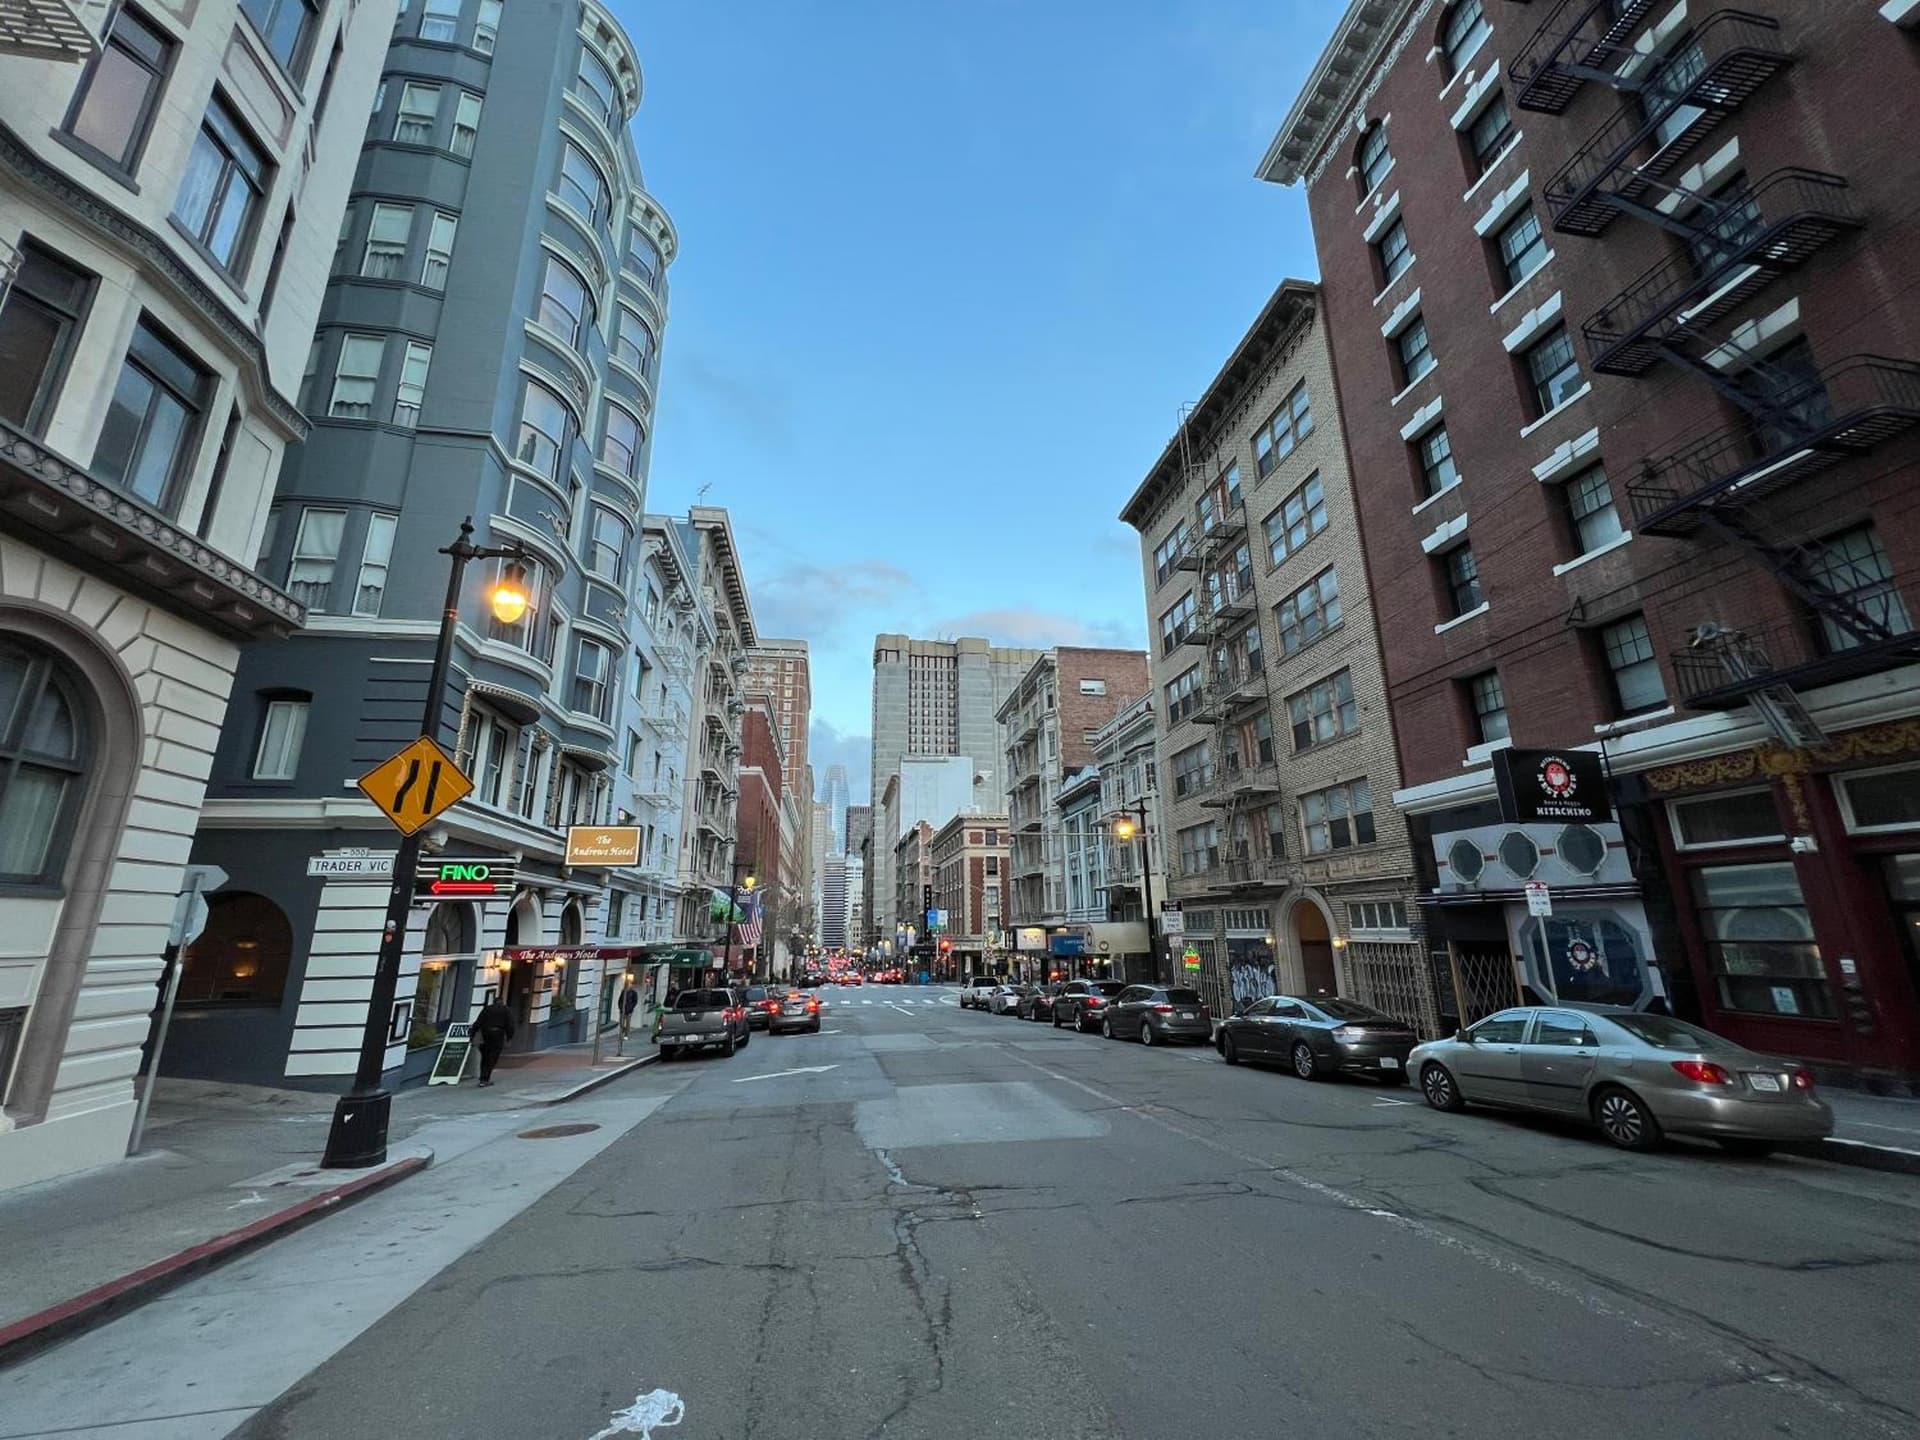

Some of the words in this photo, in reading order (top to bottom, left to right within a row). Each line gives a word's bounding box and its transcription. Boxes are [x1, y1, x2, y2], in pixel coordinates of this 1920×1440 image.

[1536, 807, 1592, 816] HITACHINO
[596, 834, 612, 844] The
[571, 847, 609, 856] Andrews
[609, 846, 635, 856] Hotel
[315, 861, 361, 871] TRADER
[369, 861, 388, 871] VIC
[441, 864, 489, 881] FINO
[520, 950, 535, 959] The
[536, 949, 573, 960] Andrews
[574, 949, 600, 960] Hotel
